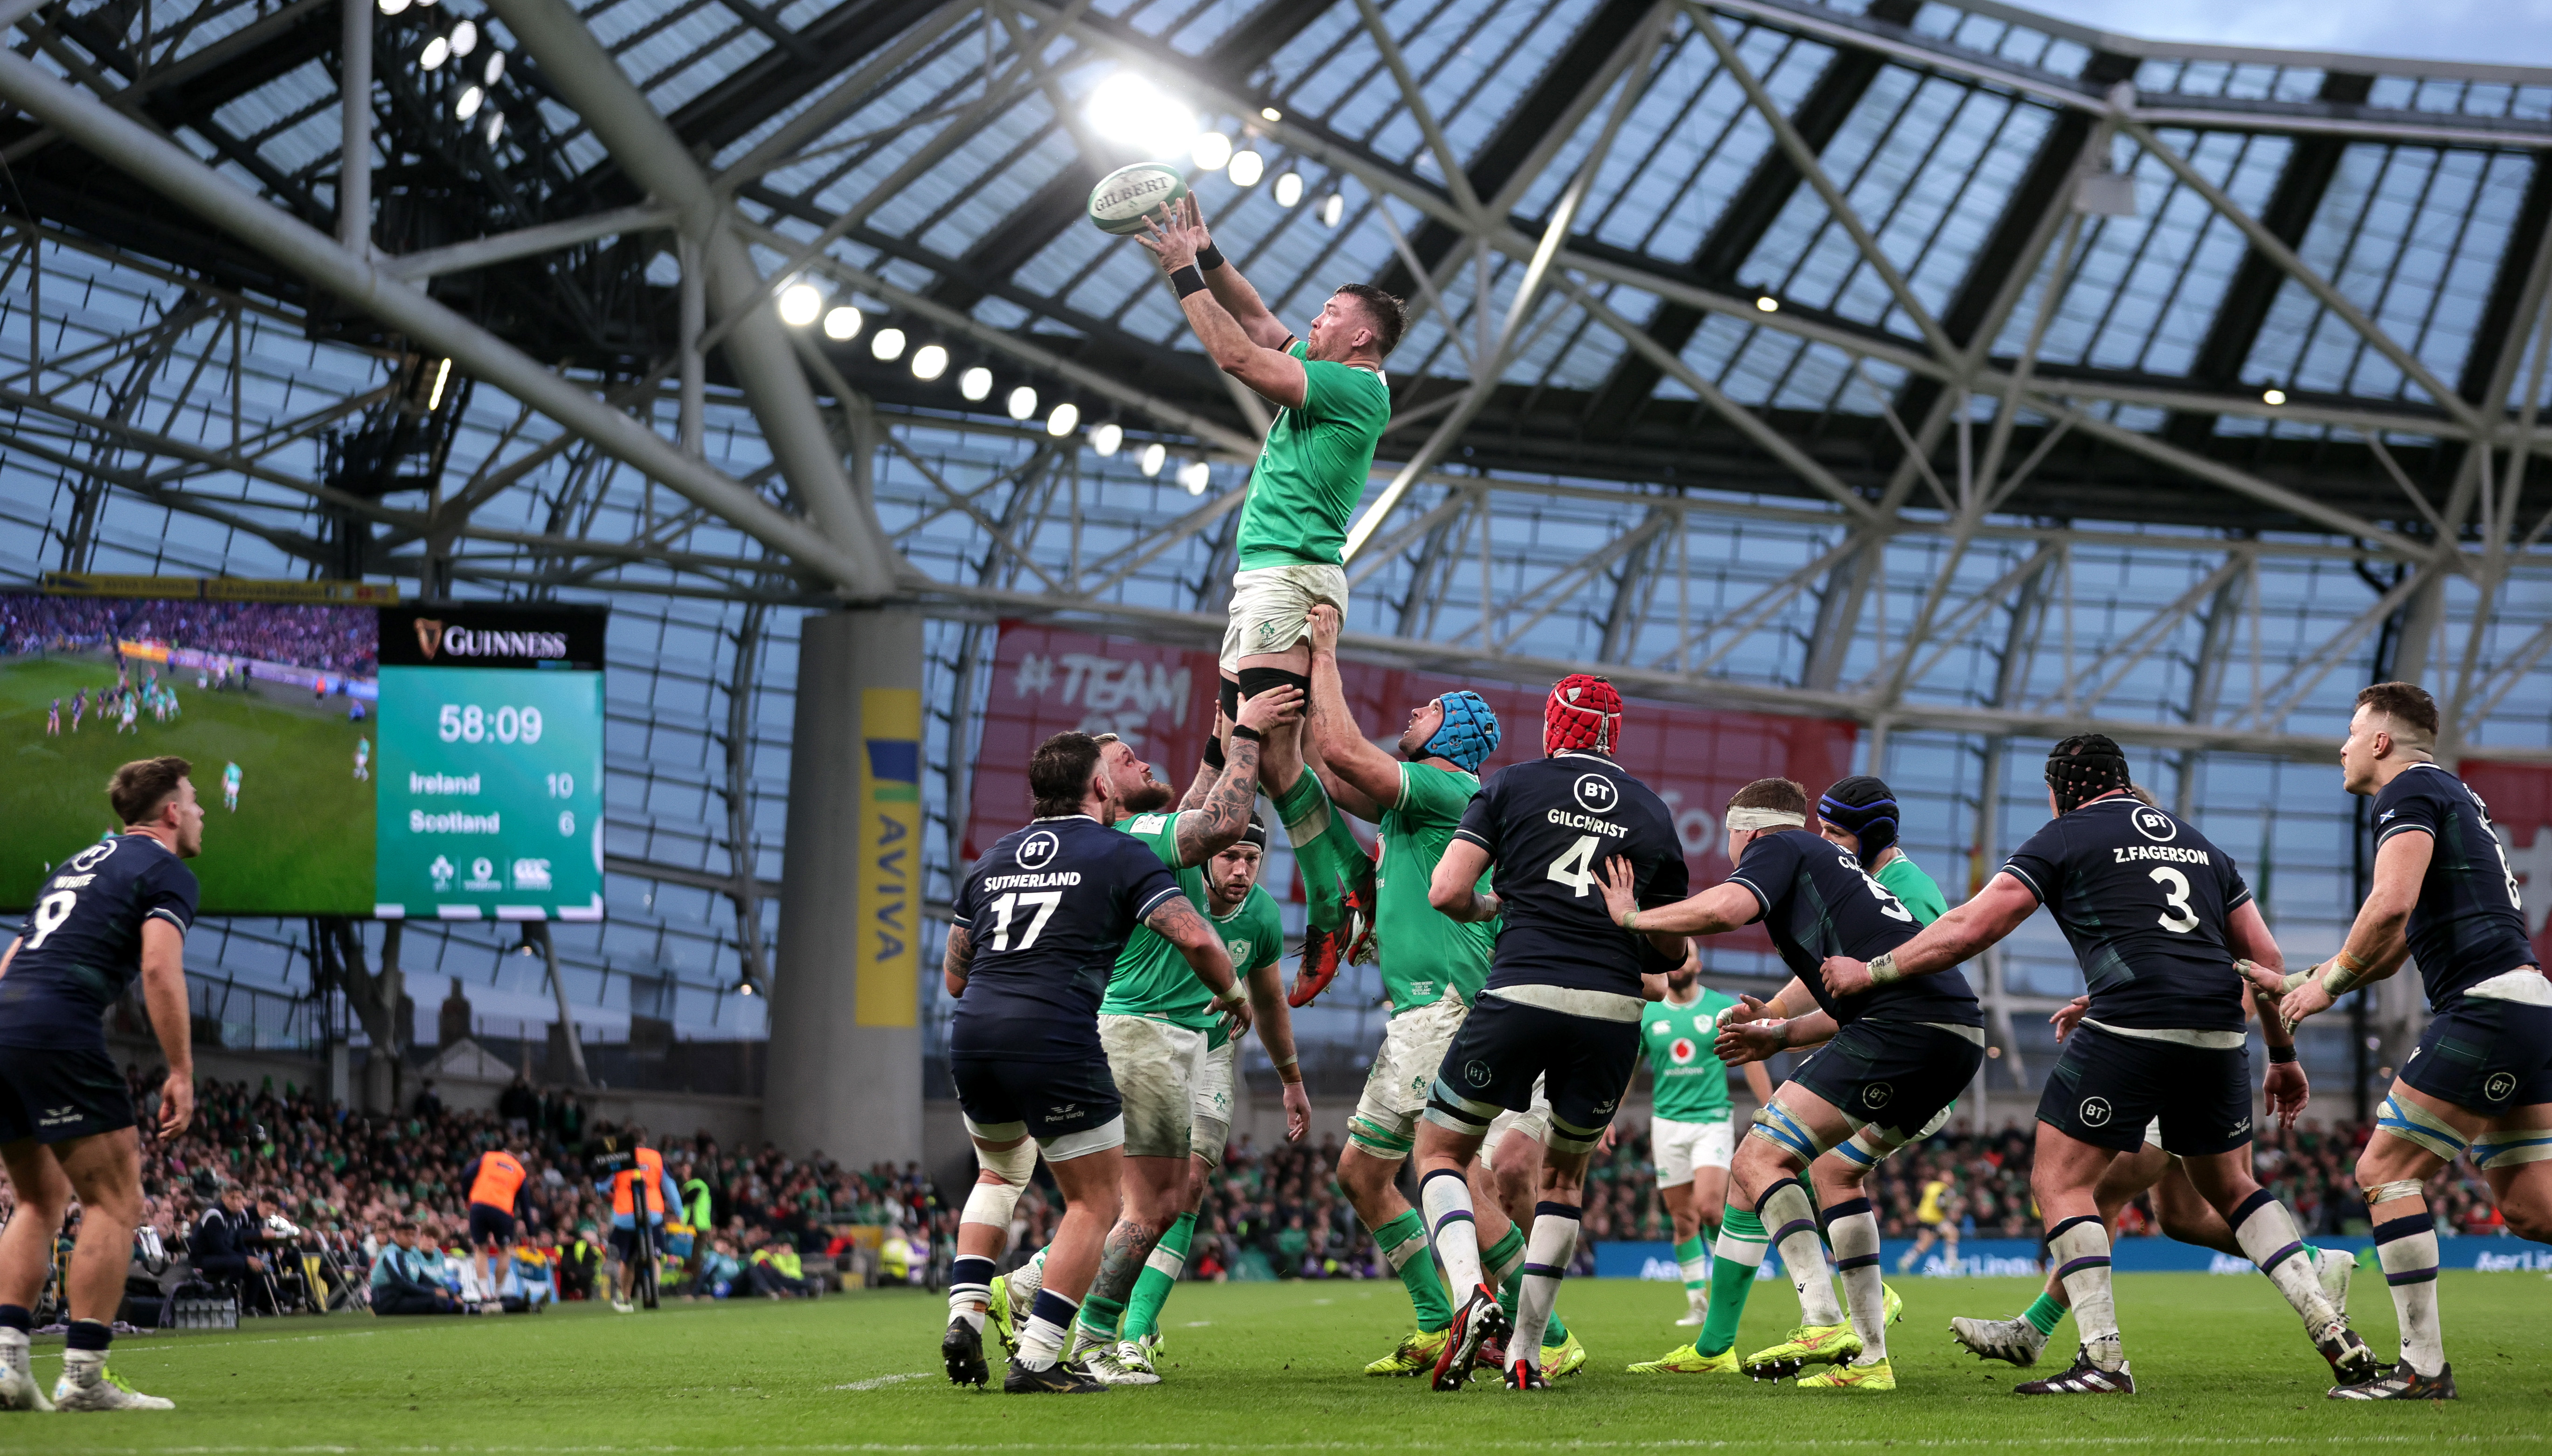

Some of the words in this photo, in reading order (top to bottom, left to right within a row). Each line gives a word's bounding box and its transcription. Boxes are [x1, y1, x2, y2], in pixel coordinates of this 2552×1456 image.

[1096, 177, 1168, 211] GILBERT
[444, 625, 567, 658] GUINNESS
[1013, 653, 1193, 729] #TEAM
[439, 704, 543, 744] 58:09
[409, 771, 481, 795] Ireland
[547, 772, 574, 798] 10
[1585, 782, 1609, 800] BT
[409, 809, 500, 835] Scotland
[561, 811, 575, 837] 6
[1547, 809, 1628, 839] GILCHRIST
[2142, 814, 2167, 828] BT
[1024, 841, 1050, 858] BT
[2113, 846, 2210, 866] Z.FAGERSON
[1547, 835, 1600, 897] 4
[53, 874, 97, 889] WHITE
[875, 813, 908, 963] AVIVA
[984, 872, 1081, 893] SUTHERLAND
[1862, 873, 1913, 922] 5
[2149, 867, 2199, 933] 3
[25, 890, 77, 950] 9
[990, 891, 1063, 951] 17
[1470, 1066, 1486, 1081] BT
[2490, 1080, 2510, 1094] BT
[1869, 1088, 1888, 1102] BT
[1066, 1110, 1085, 1119] Vardy
[2086, 1103, 2107, 1119] BT
